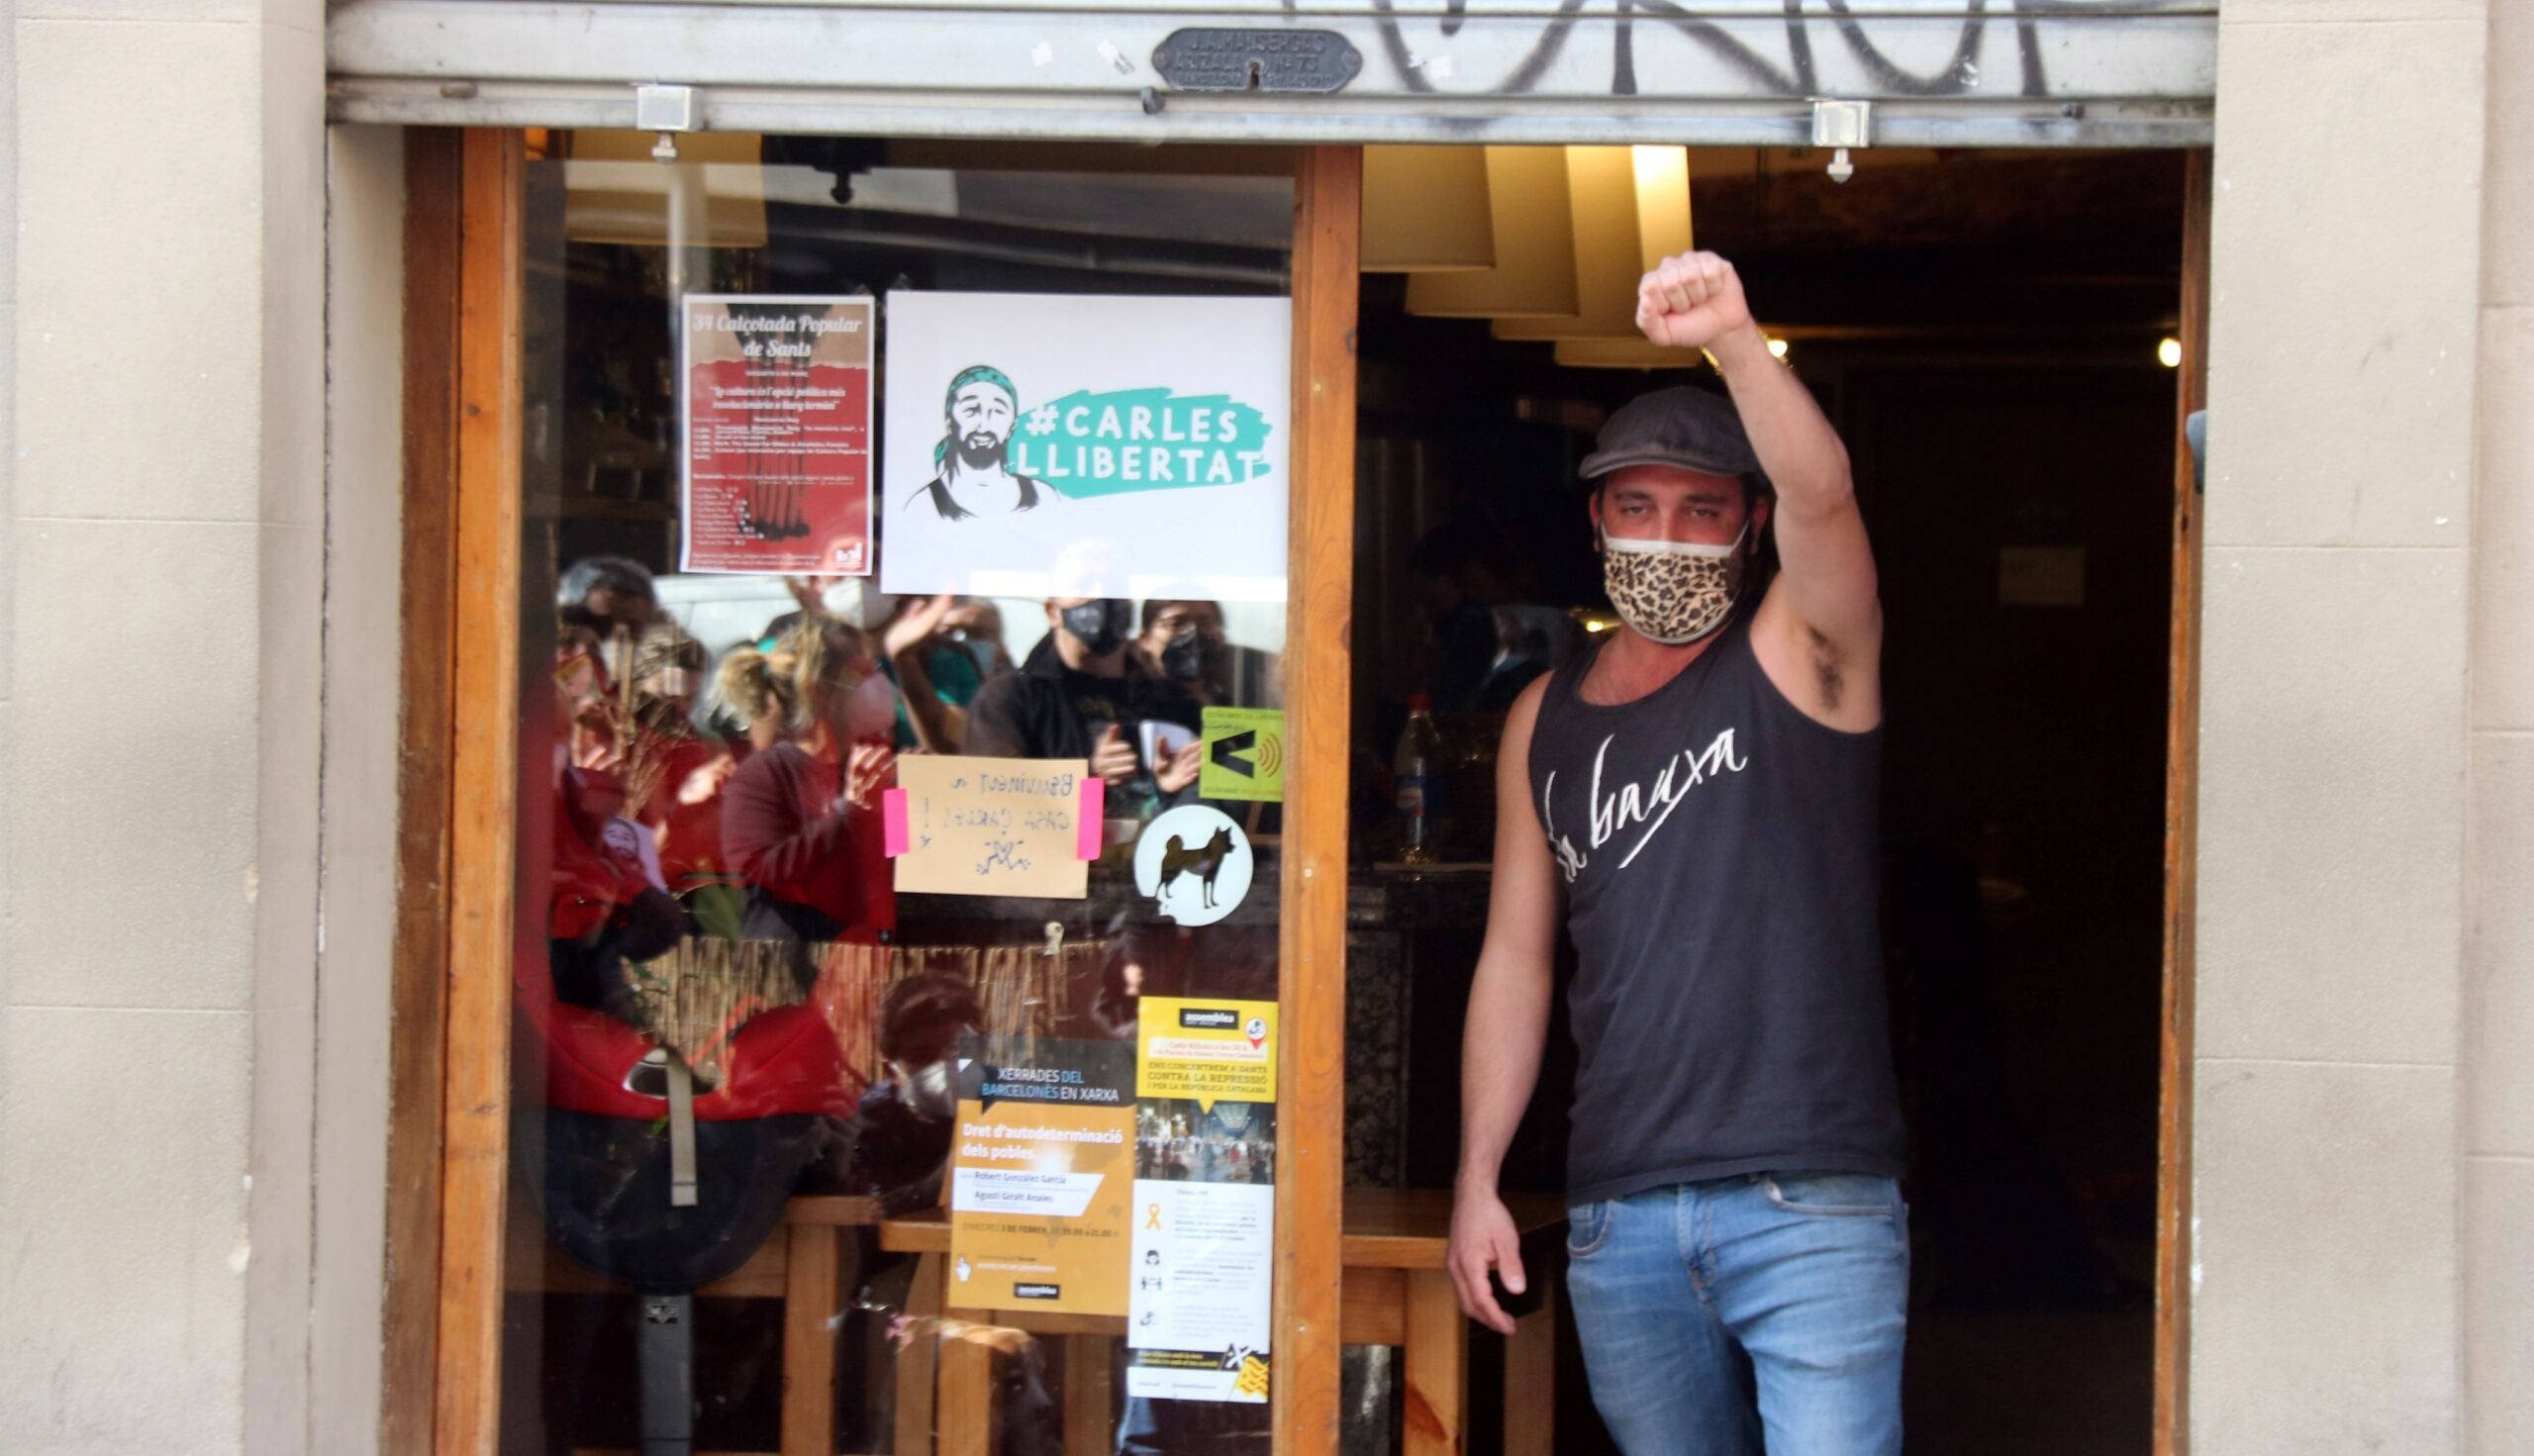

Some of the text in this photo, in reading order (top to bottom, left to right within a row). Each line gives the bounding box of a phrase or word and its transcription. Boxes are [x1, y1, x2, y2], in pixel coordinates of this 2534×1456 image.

[718, 313, 796, 336] Calçotada
[799, 313, 863, 336] Popular
[744, 338, 812, 356] de Sants
[1024, 405, 1238, 443] #CARLES
[1017, 441, 1264, 484] LLIBERTAT
[1185, 1013, 1235, 1023] assemblea
[998, 1067, 1085, 1084] XERRADES DEL
[1148, 1071, 1191, 1081] CONTRA
[981, 1081, 1120, 1101] BARCELONÈS EN XARXA
[961, 1122, 1123, 1143] Dret d'autodeterminació
[960, 1143, 989, 1156] dels
[974, 1170, 1002, 1181] Robert
